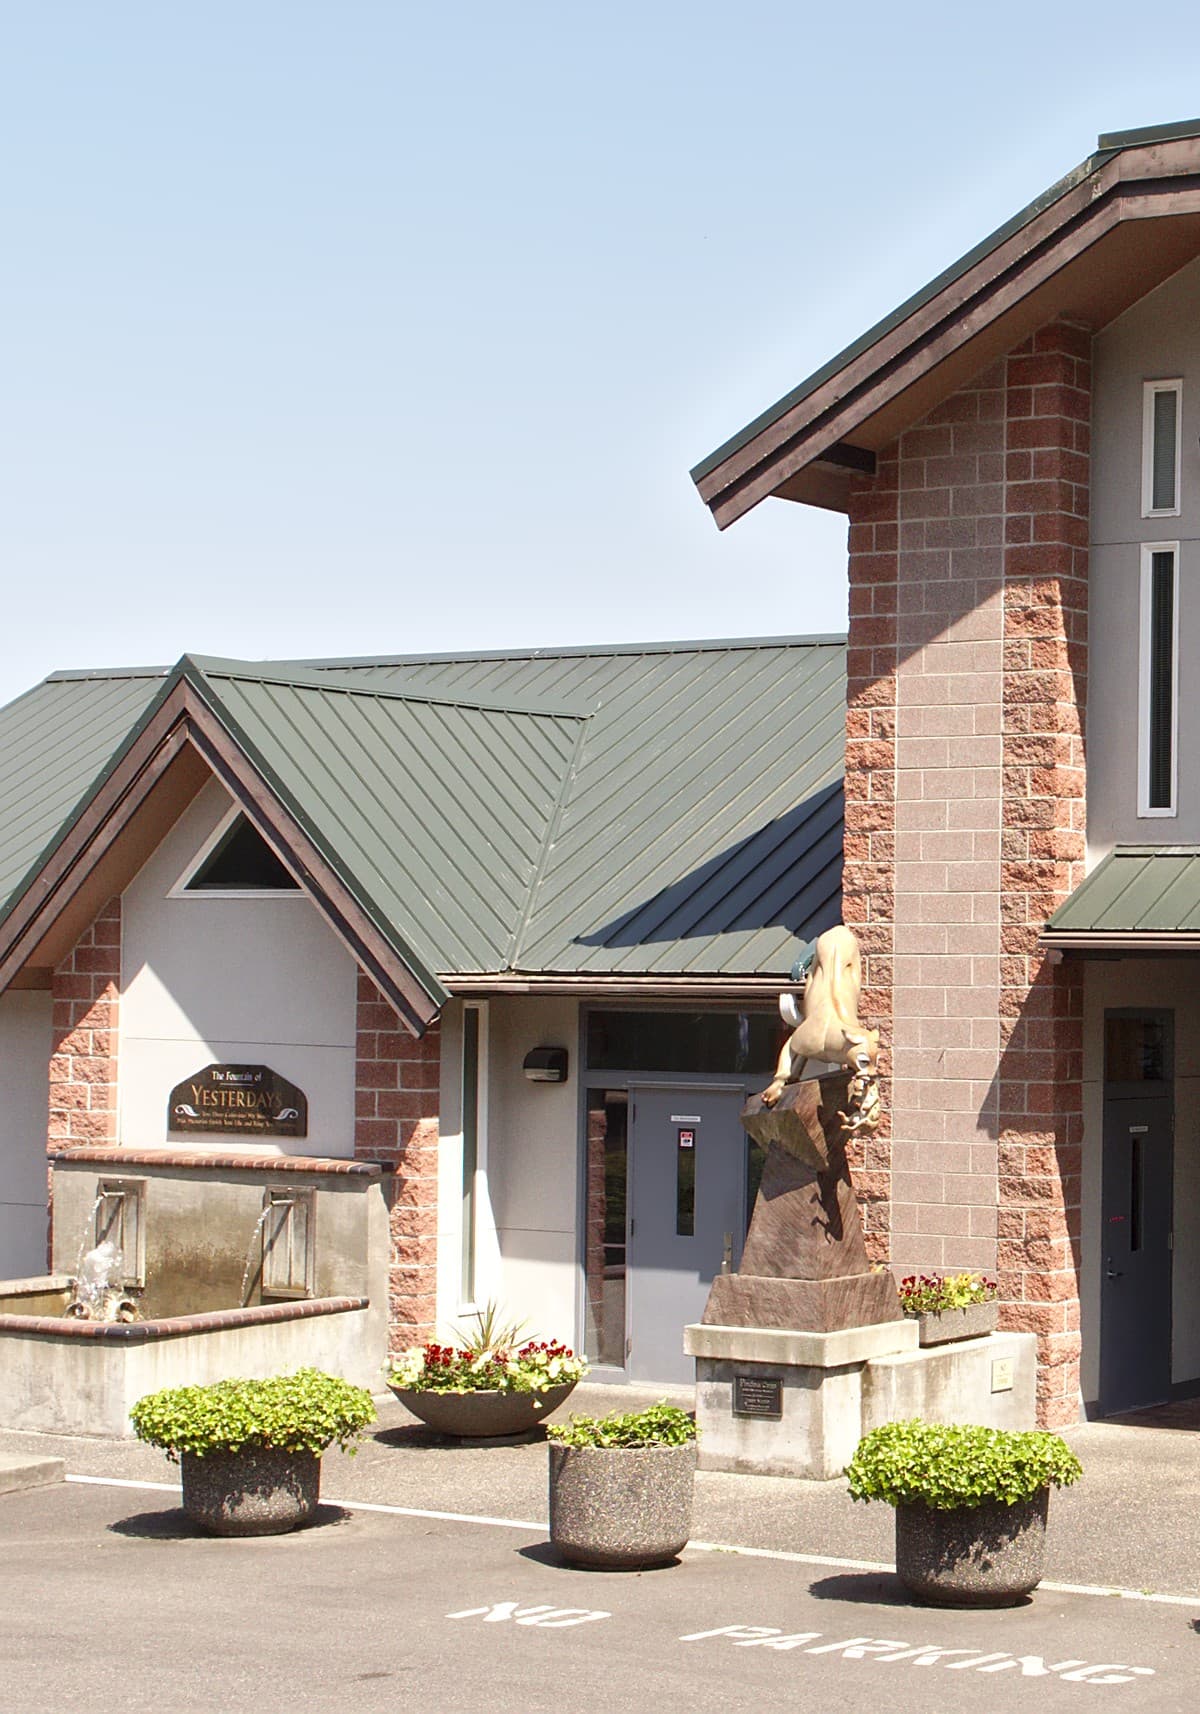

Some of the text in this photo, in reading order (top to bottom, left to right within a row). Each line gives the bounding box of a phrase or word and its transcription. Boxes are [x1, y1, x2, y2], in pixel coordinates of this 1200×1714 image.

[212, 1071, 225, 1081] The
[254, 1071, 262, 1082] of
[191, 1084, 282, 1108] YESTERDAYS
[445, 1601, 612, 1628] NO
[679, 1624, 1156, 1685] PARKING
